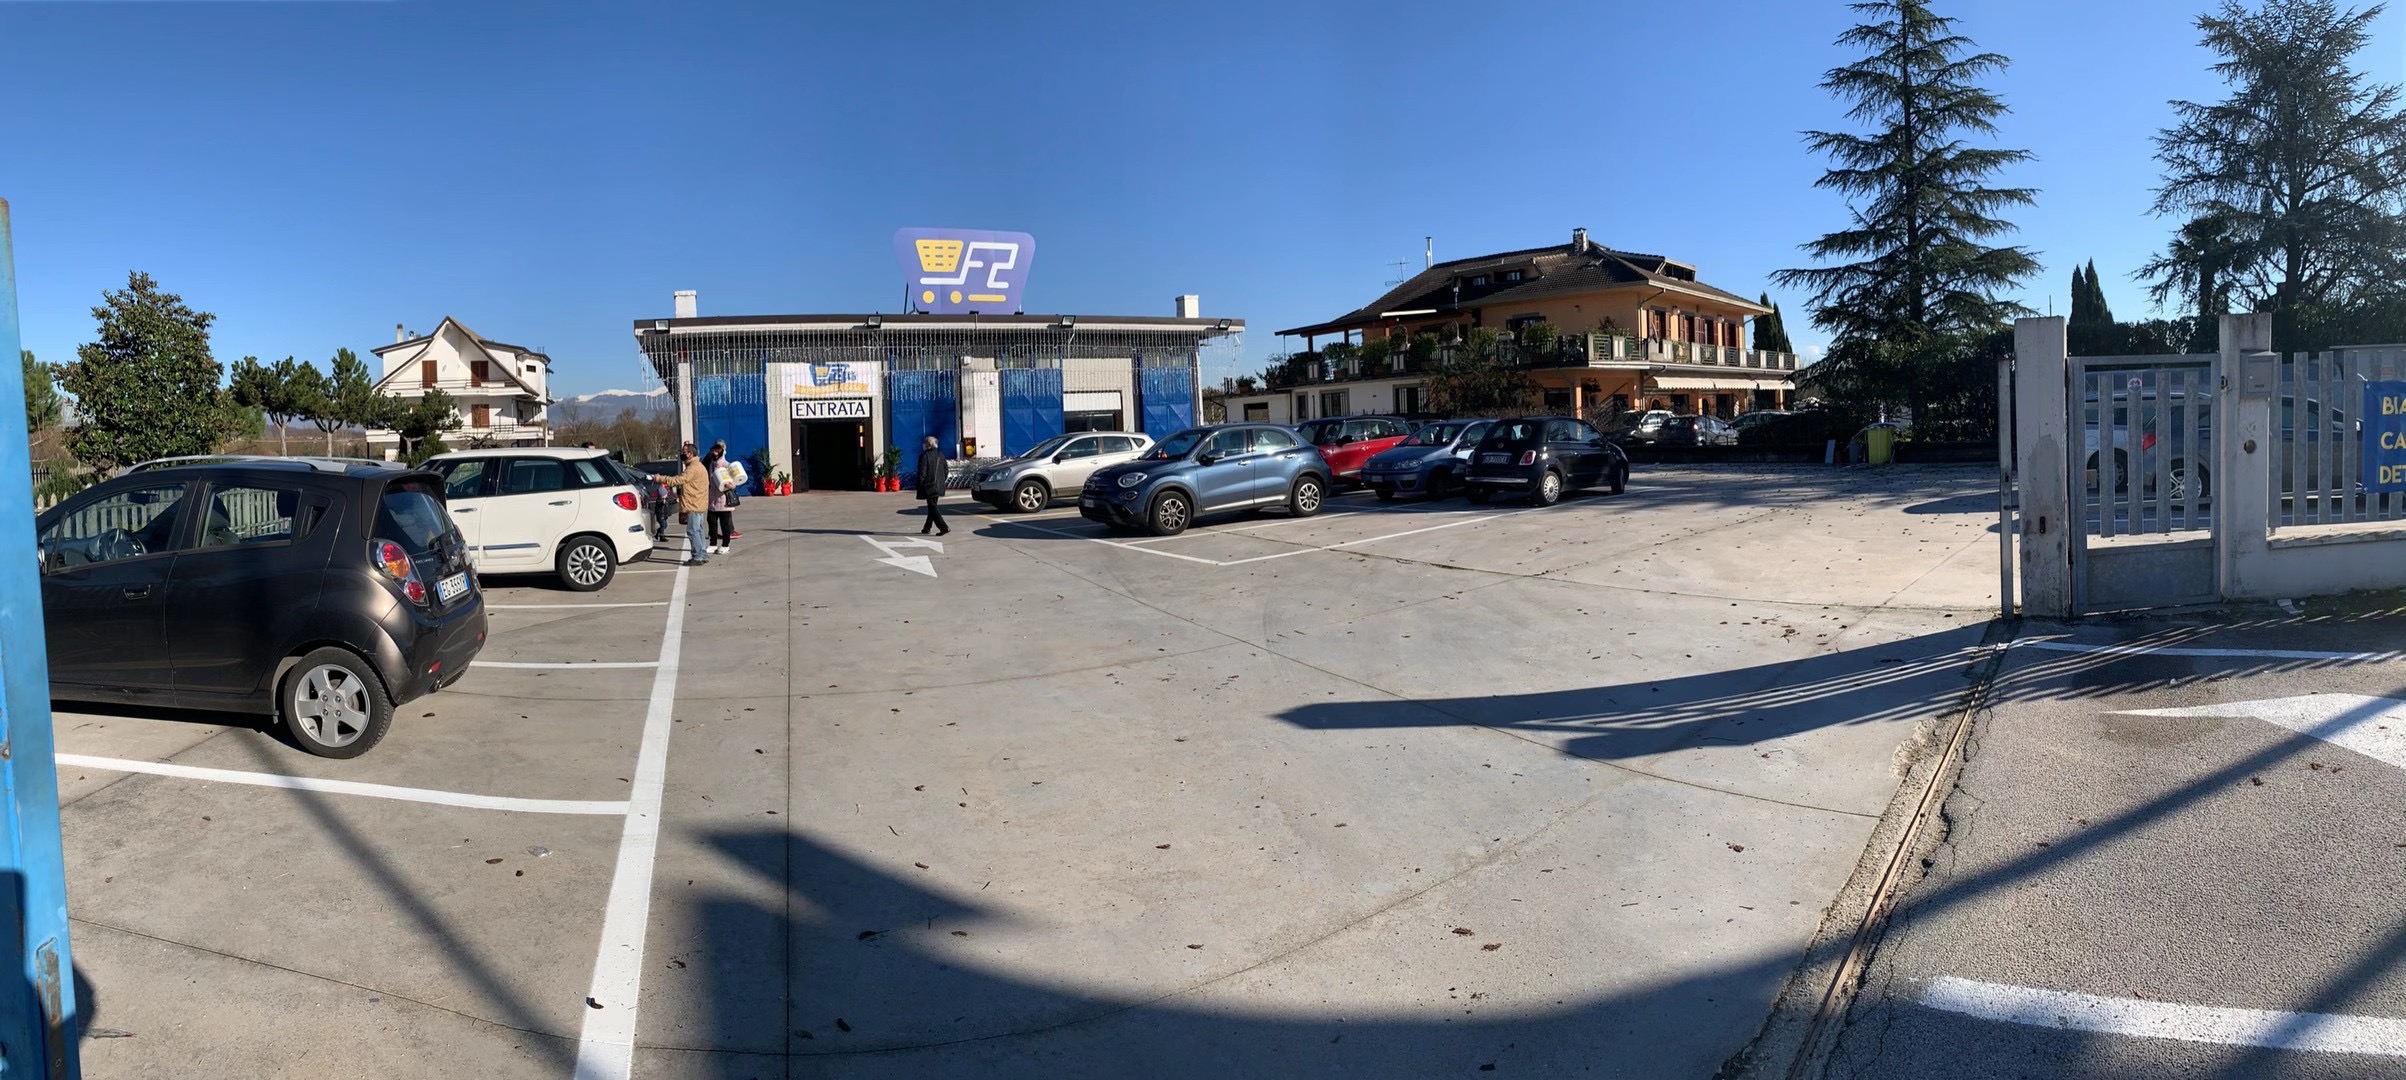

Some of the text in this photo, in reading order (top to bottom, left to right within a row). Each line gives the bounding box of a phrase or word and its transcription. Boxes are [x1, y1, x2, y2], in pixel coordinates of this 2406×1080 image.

[960, 241, 1019, 289] F2
[795, 401, 866, 417] ENTRATA
[2380, 431, 2406, 450] CA
